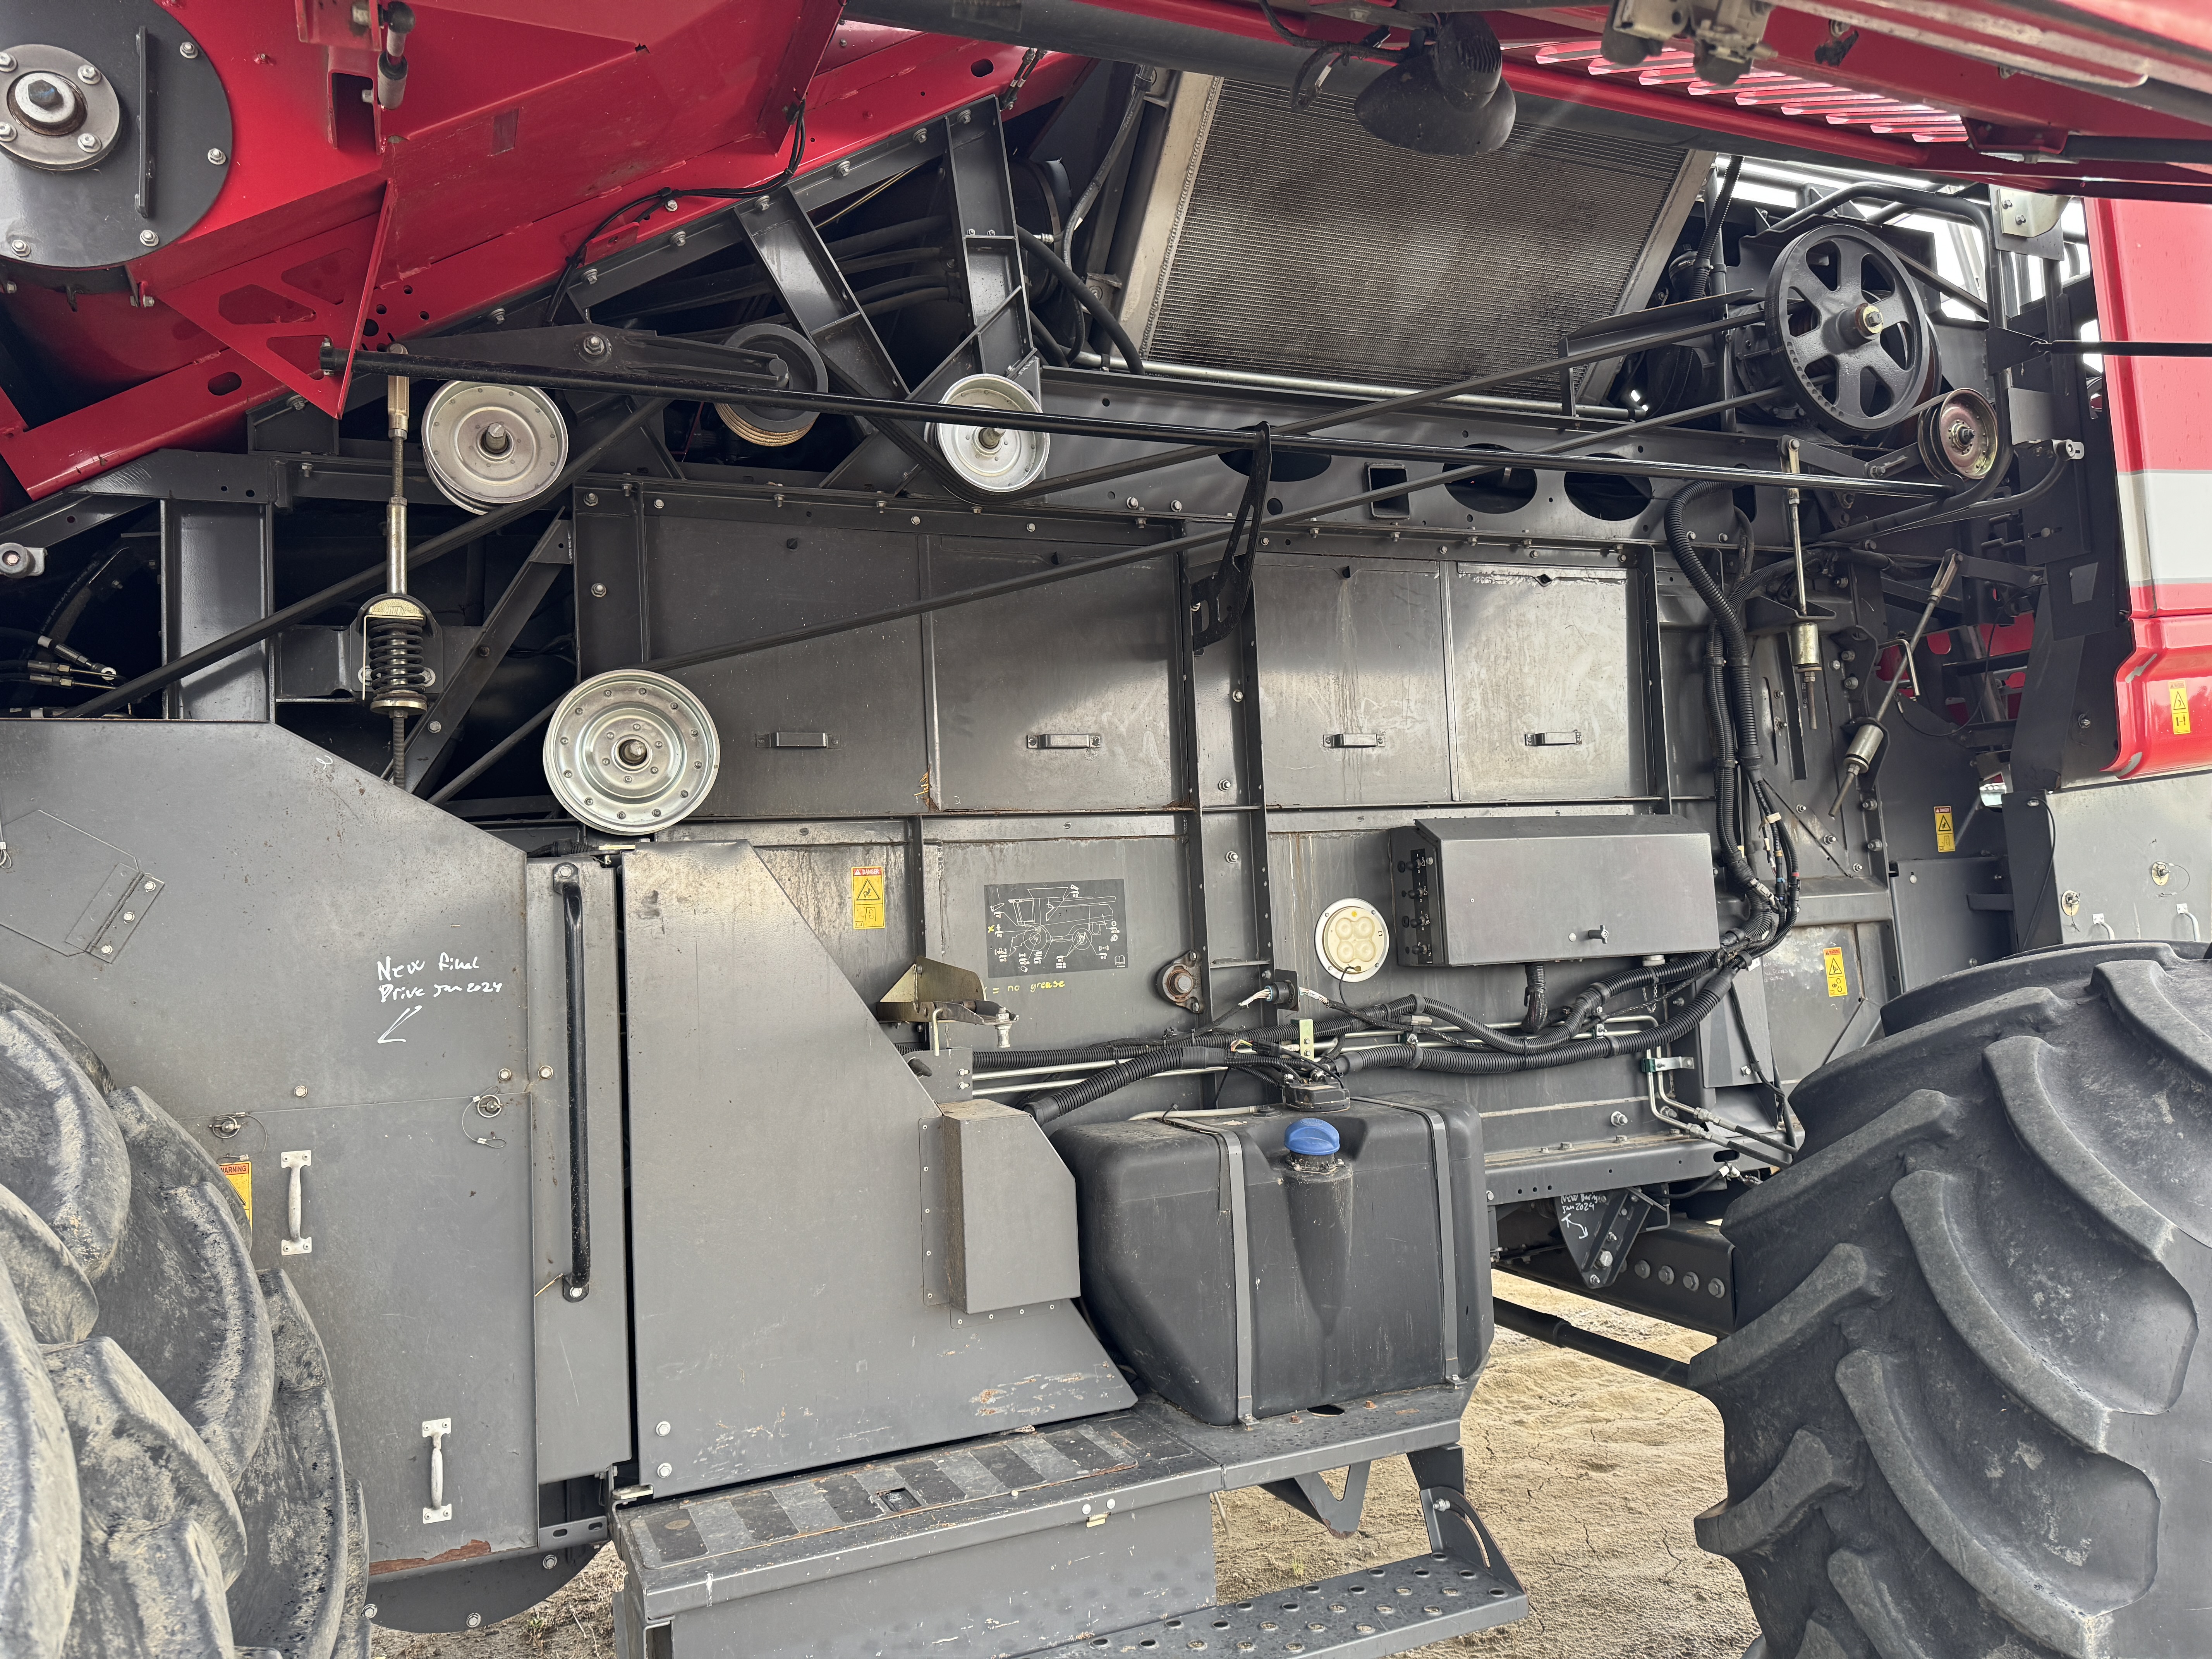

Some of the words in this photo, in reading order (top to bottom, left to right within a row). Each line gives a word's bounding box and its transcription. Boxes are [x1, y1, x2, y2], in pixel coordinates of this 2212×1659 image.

[1442, 787, 1448, 798] 3
[377, 955, 425, 981] New
[378, 984, 425, 1003] Drive
[467, 982, 503, 993] 2024
[1030, 980, 1065, 993] grease
[1575, 1202, 1594, 1211] 2024
